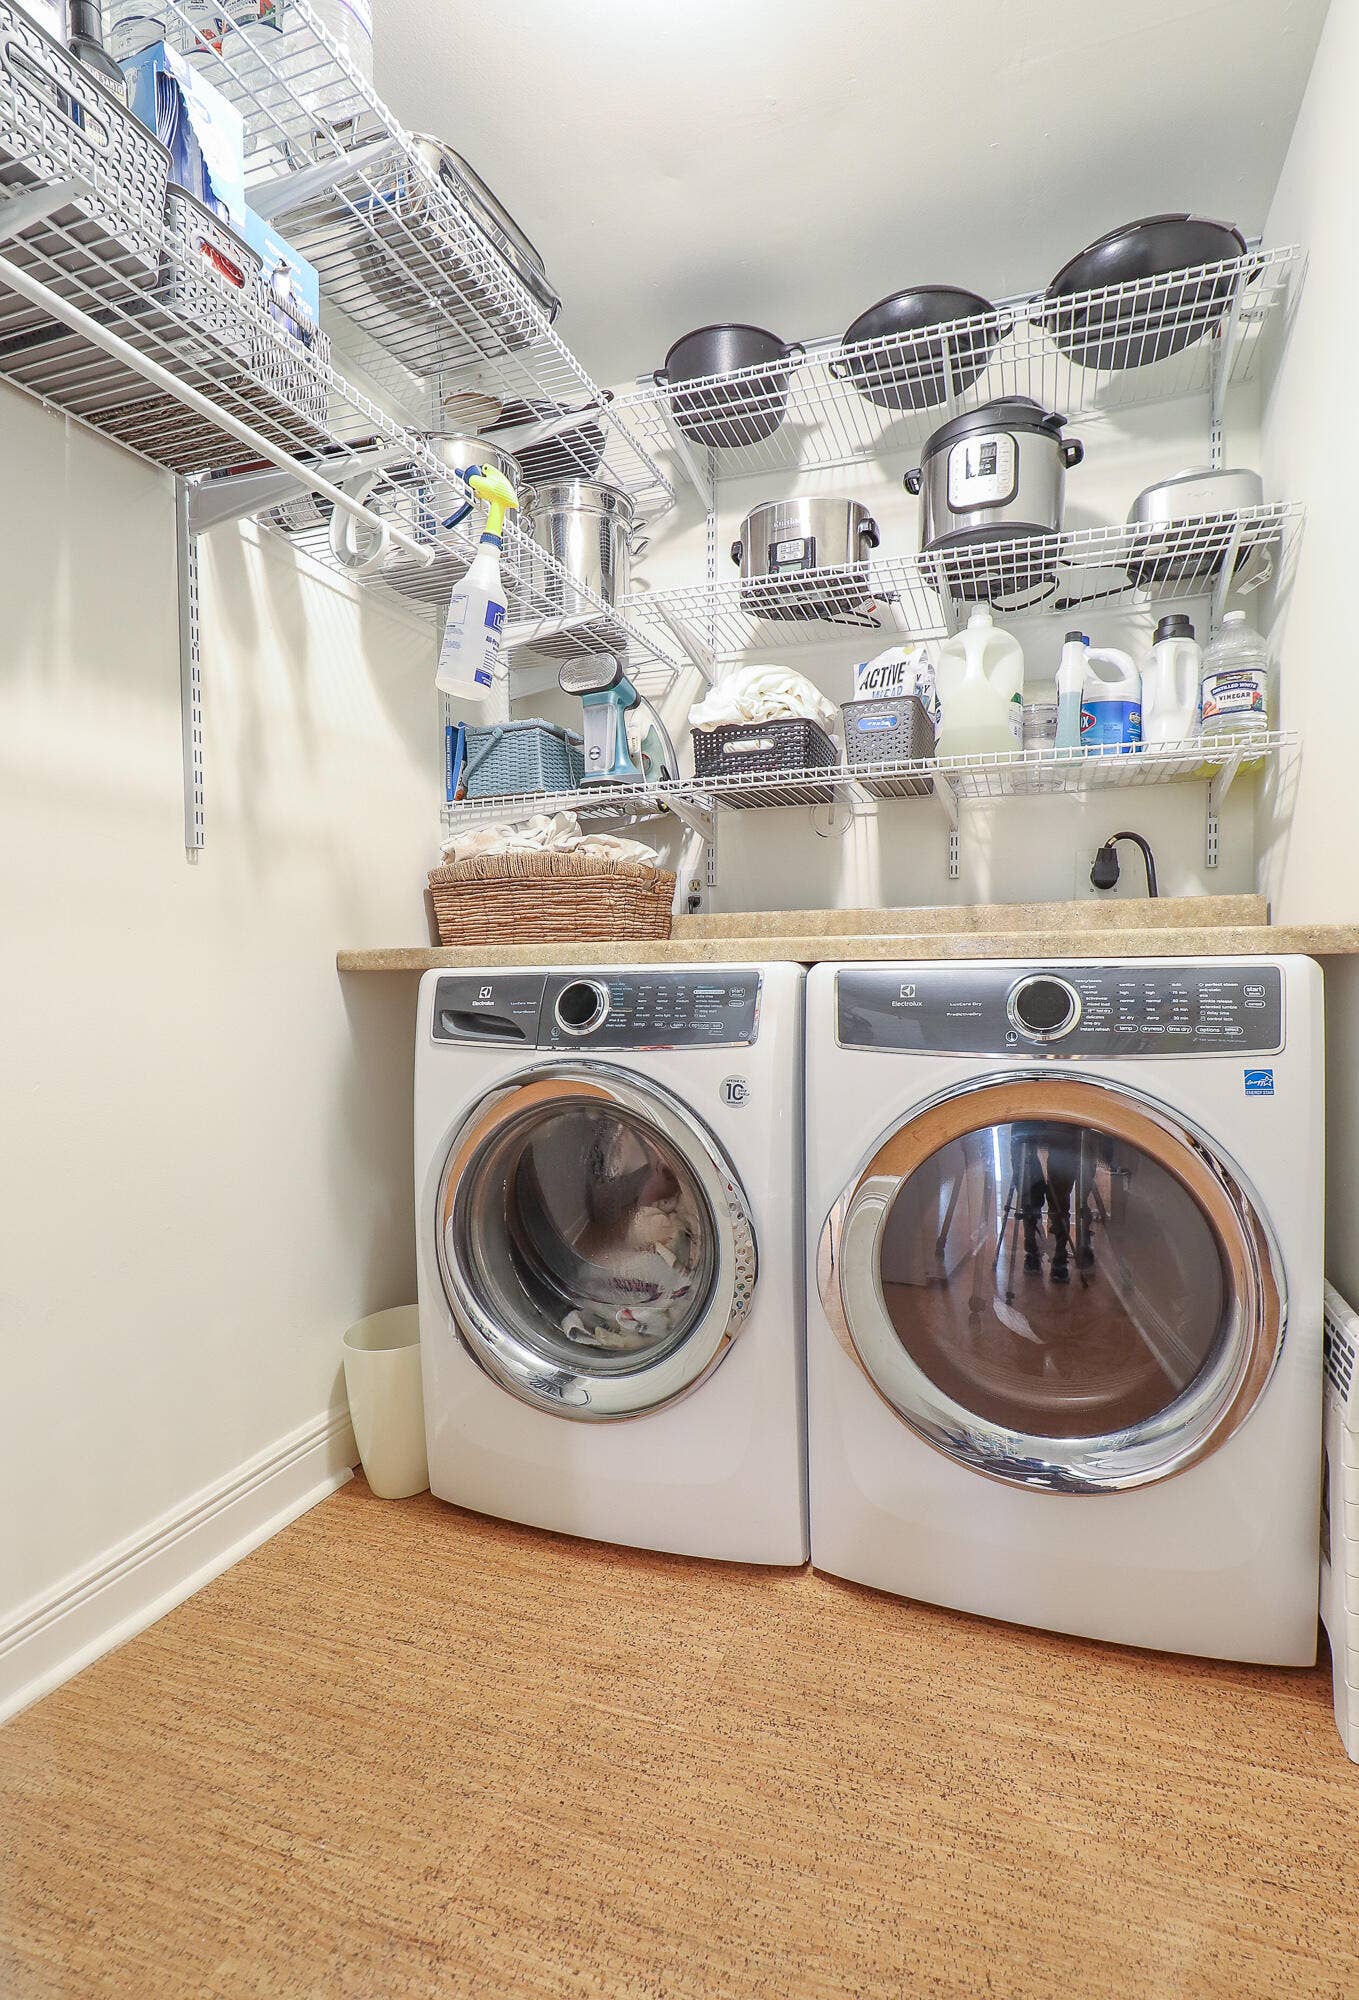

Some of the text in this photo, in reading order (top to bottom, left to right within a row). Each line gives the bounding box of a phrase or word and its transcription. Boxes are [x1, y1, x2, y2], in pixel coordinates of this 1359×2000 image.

[859, 661, 906, 690] ACTIVE
[1212, 683, 1239, 695] DISTILLED
[1219, 691, 1251, 701] VINEGAR
